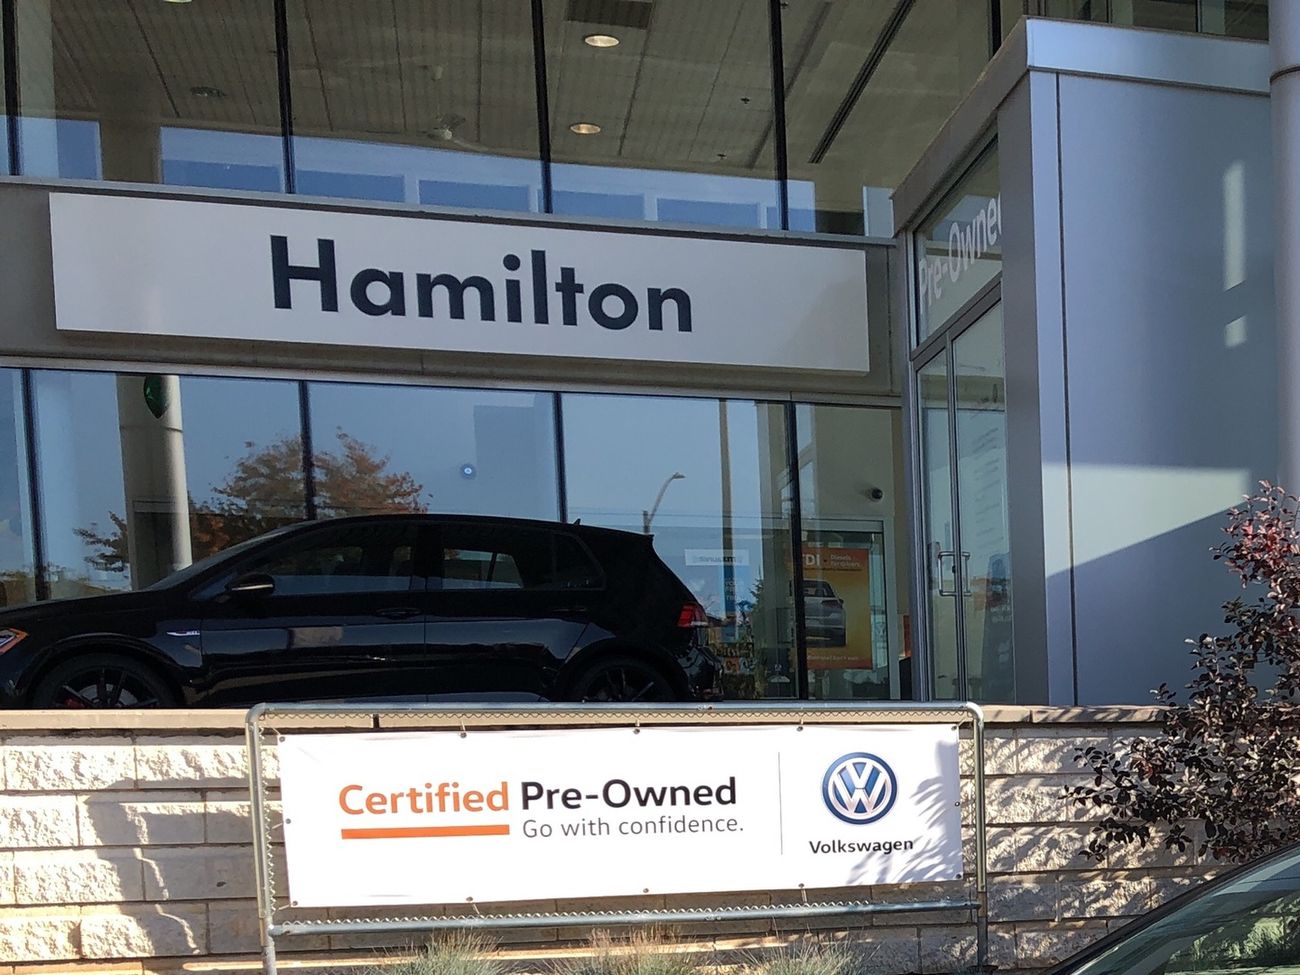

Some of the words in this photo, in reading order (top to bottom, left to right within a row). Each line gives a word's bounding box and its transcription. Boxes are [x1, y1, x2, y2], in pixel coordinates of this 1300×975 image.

[270, 235, 692, 332] Hamilton
[339, 781, 509, 815] Certified
[521, 776, 737, 810] Pre-Owned
[523, 819, 552, 838] Go
[560, 817, 610, 837] with
[618, 815, 744, 835] confidence.
[808, 839, 914, 855] Volkswagen
